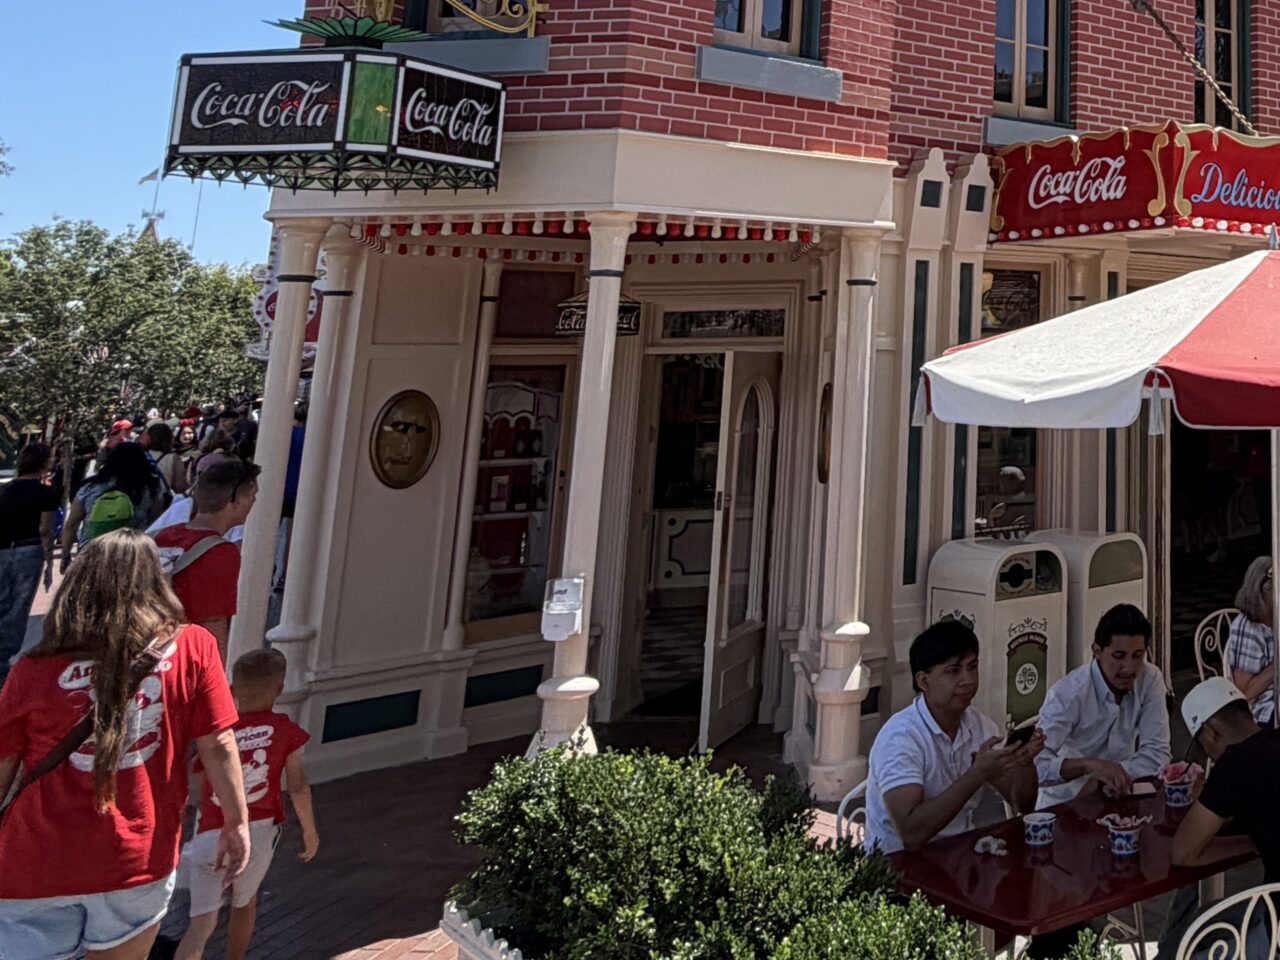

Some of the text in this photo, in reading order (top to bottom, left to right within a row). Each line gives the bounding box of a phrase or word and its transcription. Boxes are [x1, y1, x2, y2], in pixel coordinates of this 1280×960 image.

[190, 79, 332, 129] Coca-Cola
[404, 87, 498, 147] Coca-Cola
[1028, 154, 1127, 210] Coca-Cola
